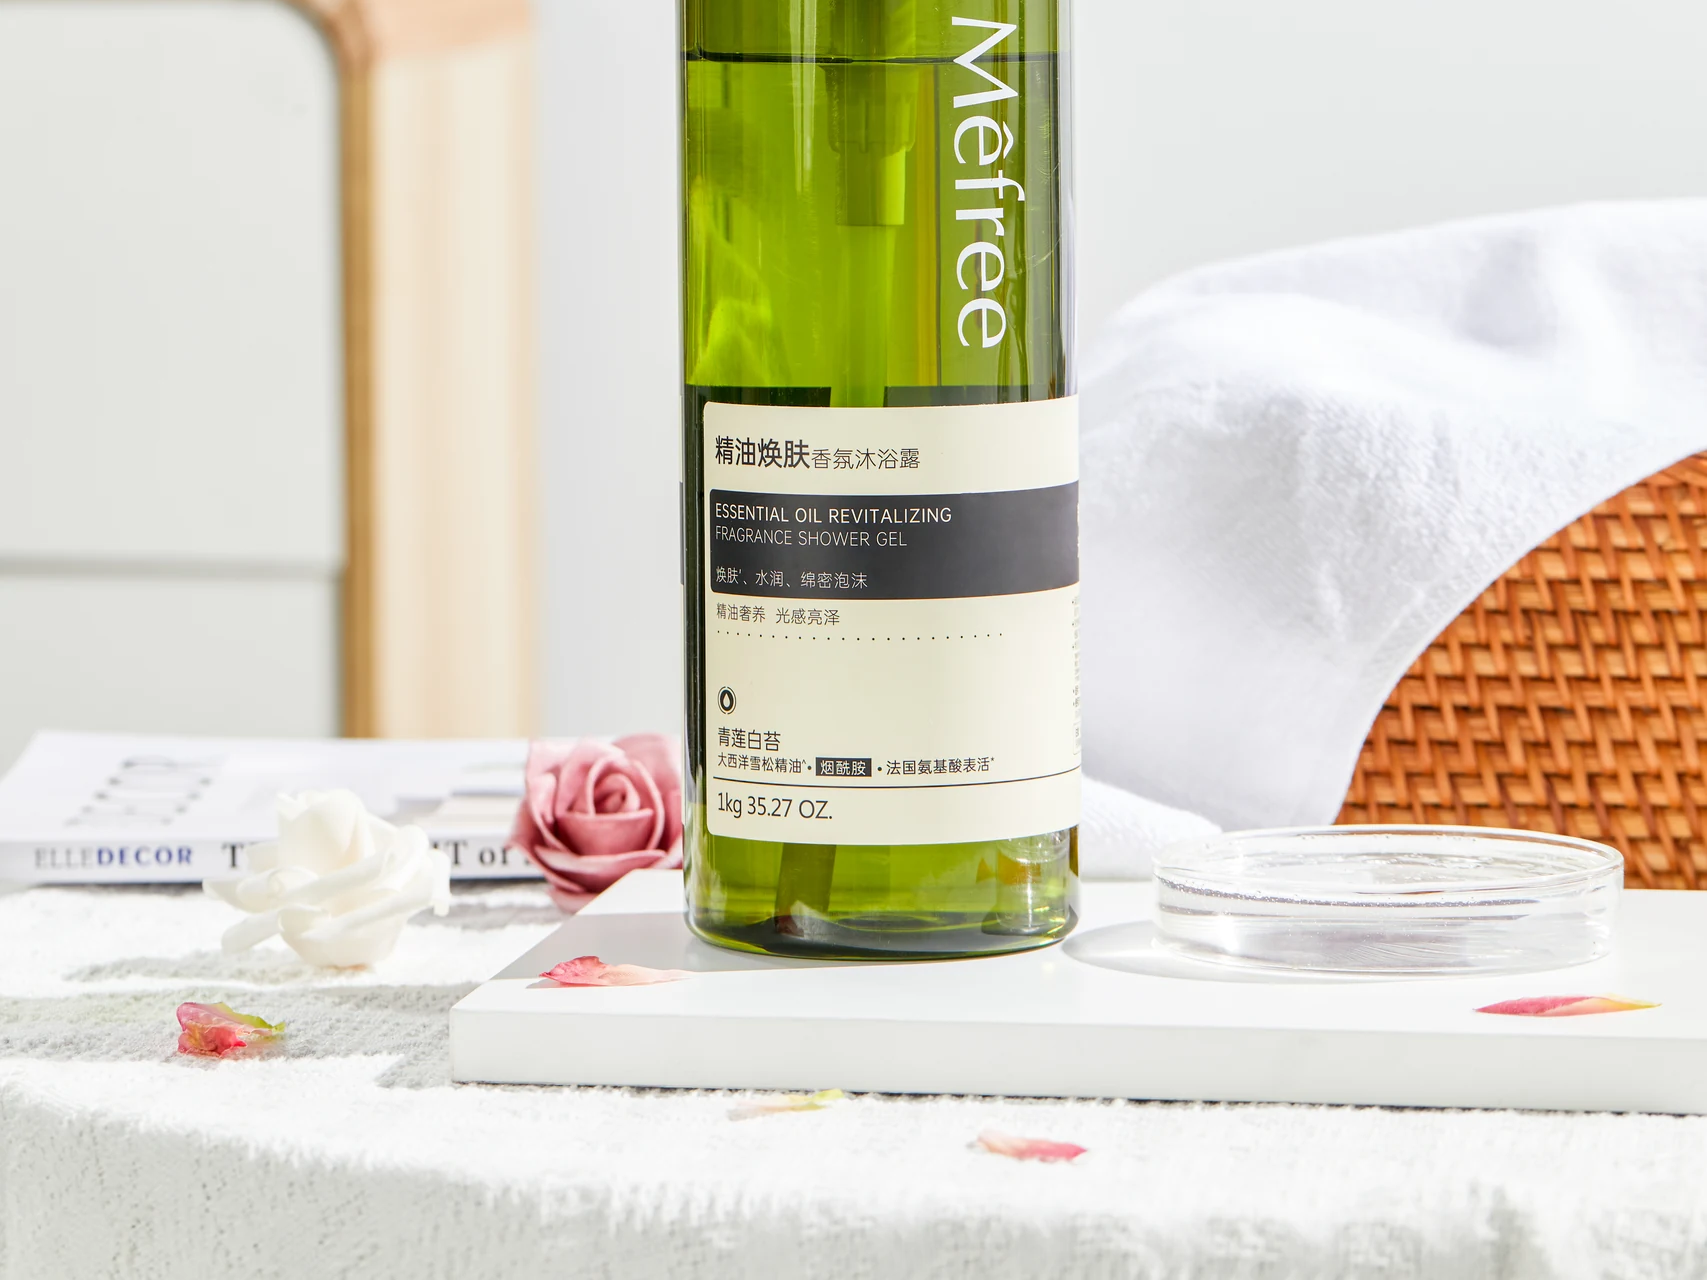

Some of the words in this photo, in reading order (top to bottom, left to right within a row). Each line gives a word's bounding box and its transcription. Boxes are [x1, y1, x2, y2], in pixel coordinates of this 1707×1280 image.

[951, 16, 1025, 348] Mêfree
[715, 435, 920, 470] 精油焕肤香氛沐浴露
[715, 503, 789, 522] ESSENTIAL
[795, 508, 822, 523] OIL
[829, 507, 952, 524] REVITALIZING
[715, 525, 792, 545] FRAGRANCE
[798, 530, 870, 547] SHOWER
[876, 531, 907, 547] GEL
[716, 602, 766, 623] 精油奢养
[775, 607, 840, 626] 光感亮泽
[718, 726, 781, 751] 青莲白苔
[820, 759, 866, 776] 烟酰胺
[718, 792, 742, 819] 1kg
[747, 795, 793, 818] 35.27
[799, 799, 833, 820] OZ.
